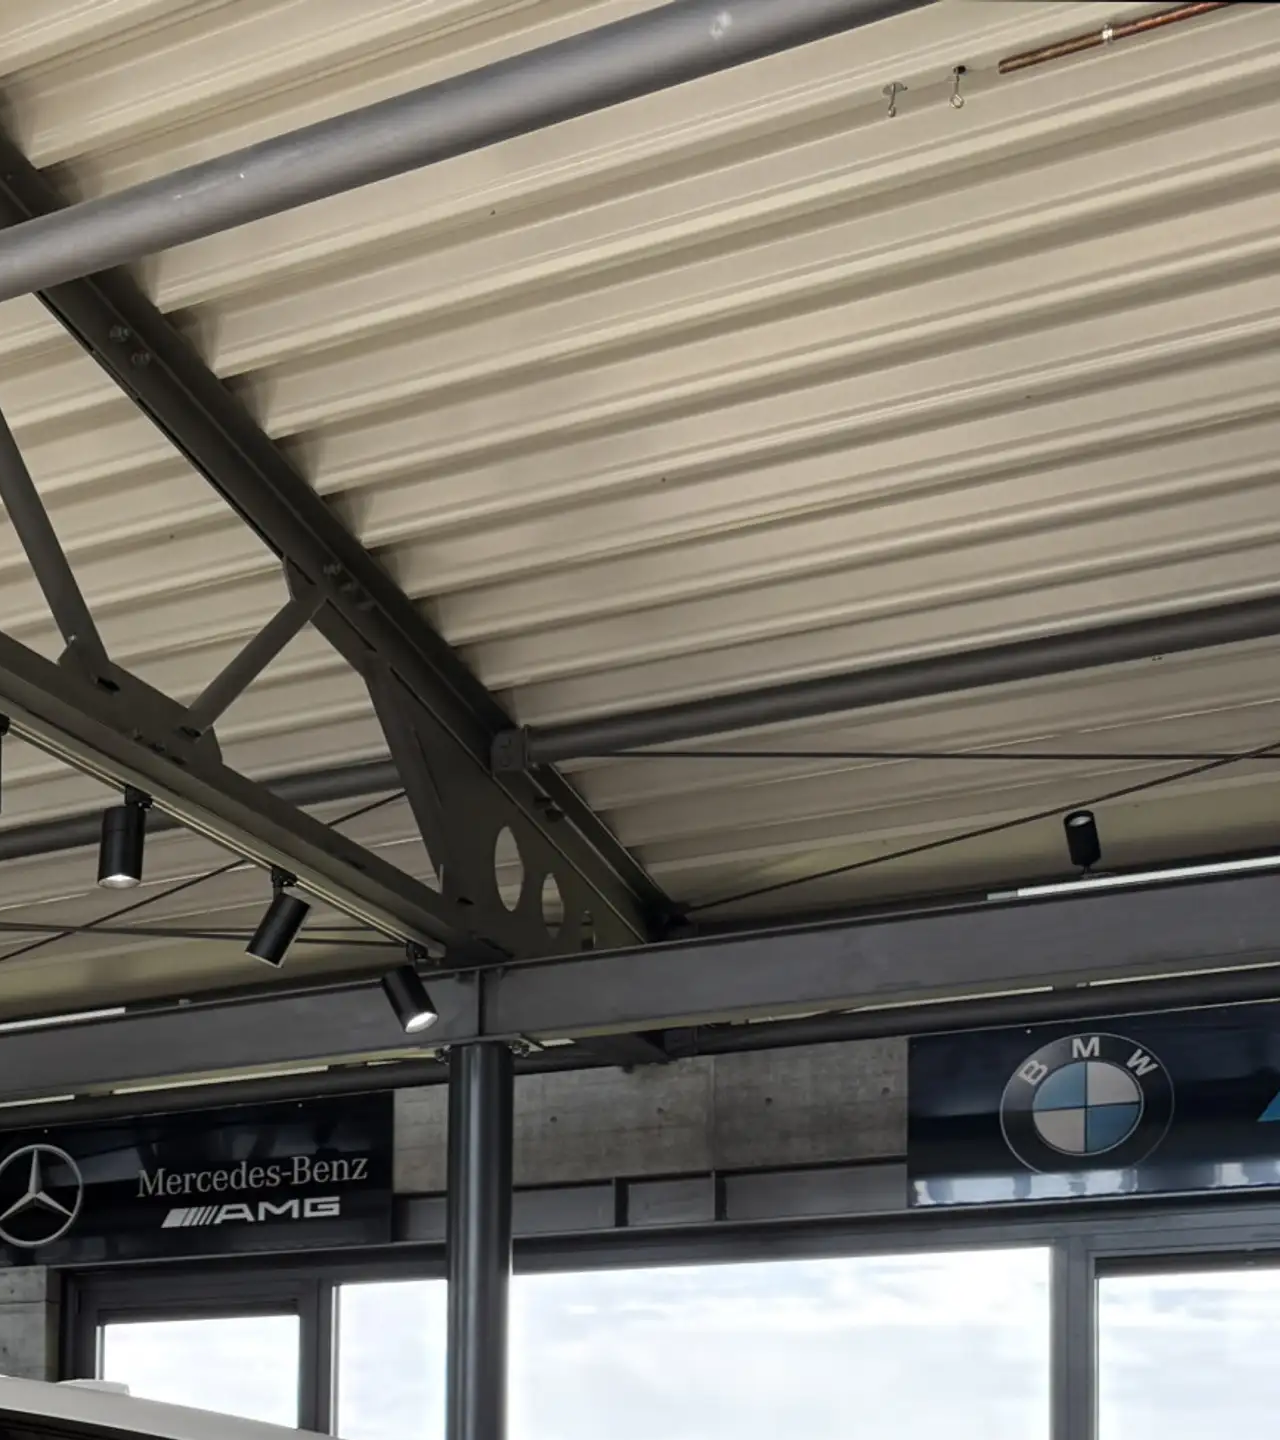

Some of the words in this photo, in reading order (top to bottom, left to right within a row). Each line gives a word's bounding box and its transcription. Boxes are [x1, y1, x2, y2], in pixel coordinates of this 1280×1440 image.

[1017, 1036, 1159, 1086] BMW
[136, 1155, 369, 1198] Mercedes-Benz
[213, 1196, 340, 1224] AMG
